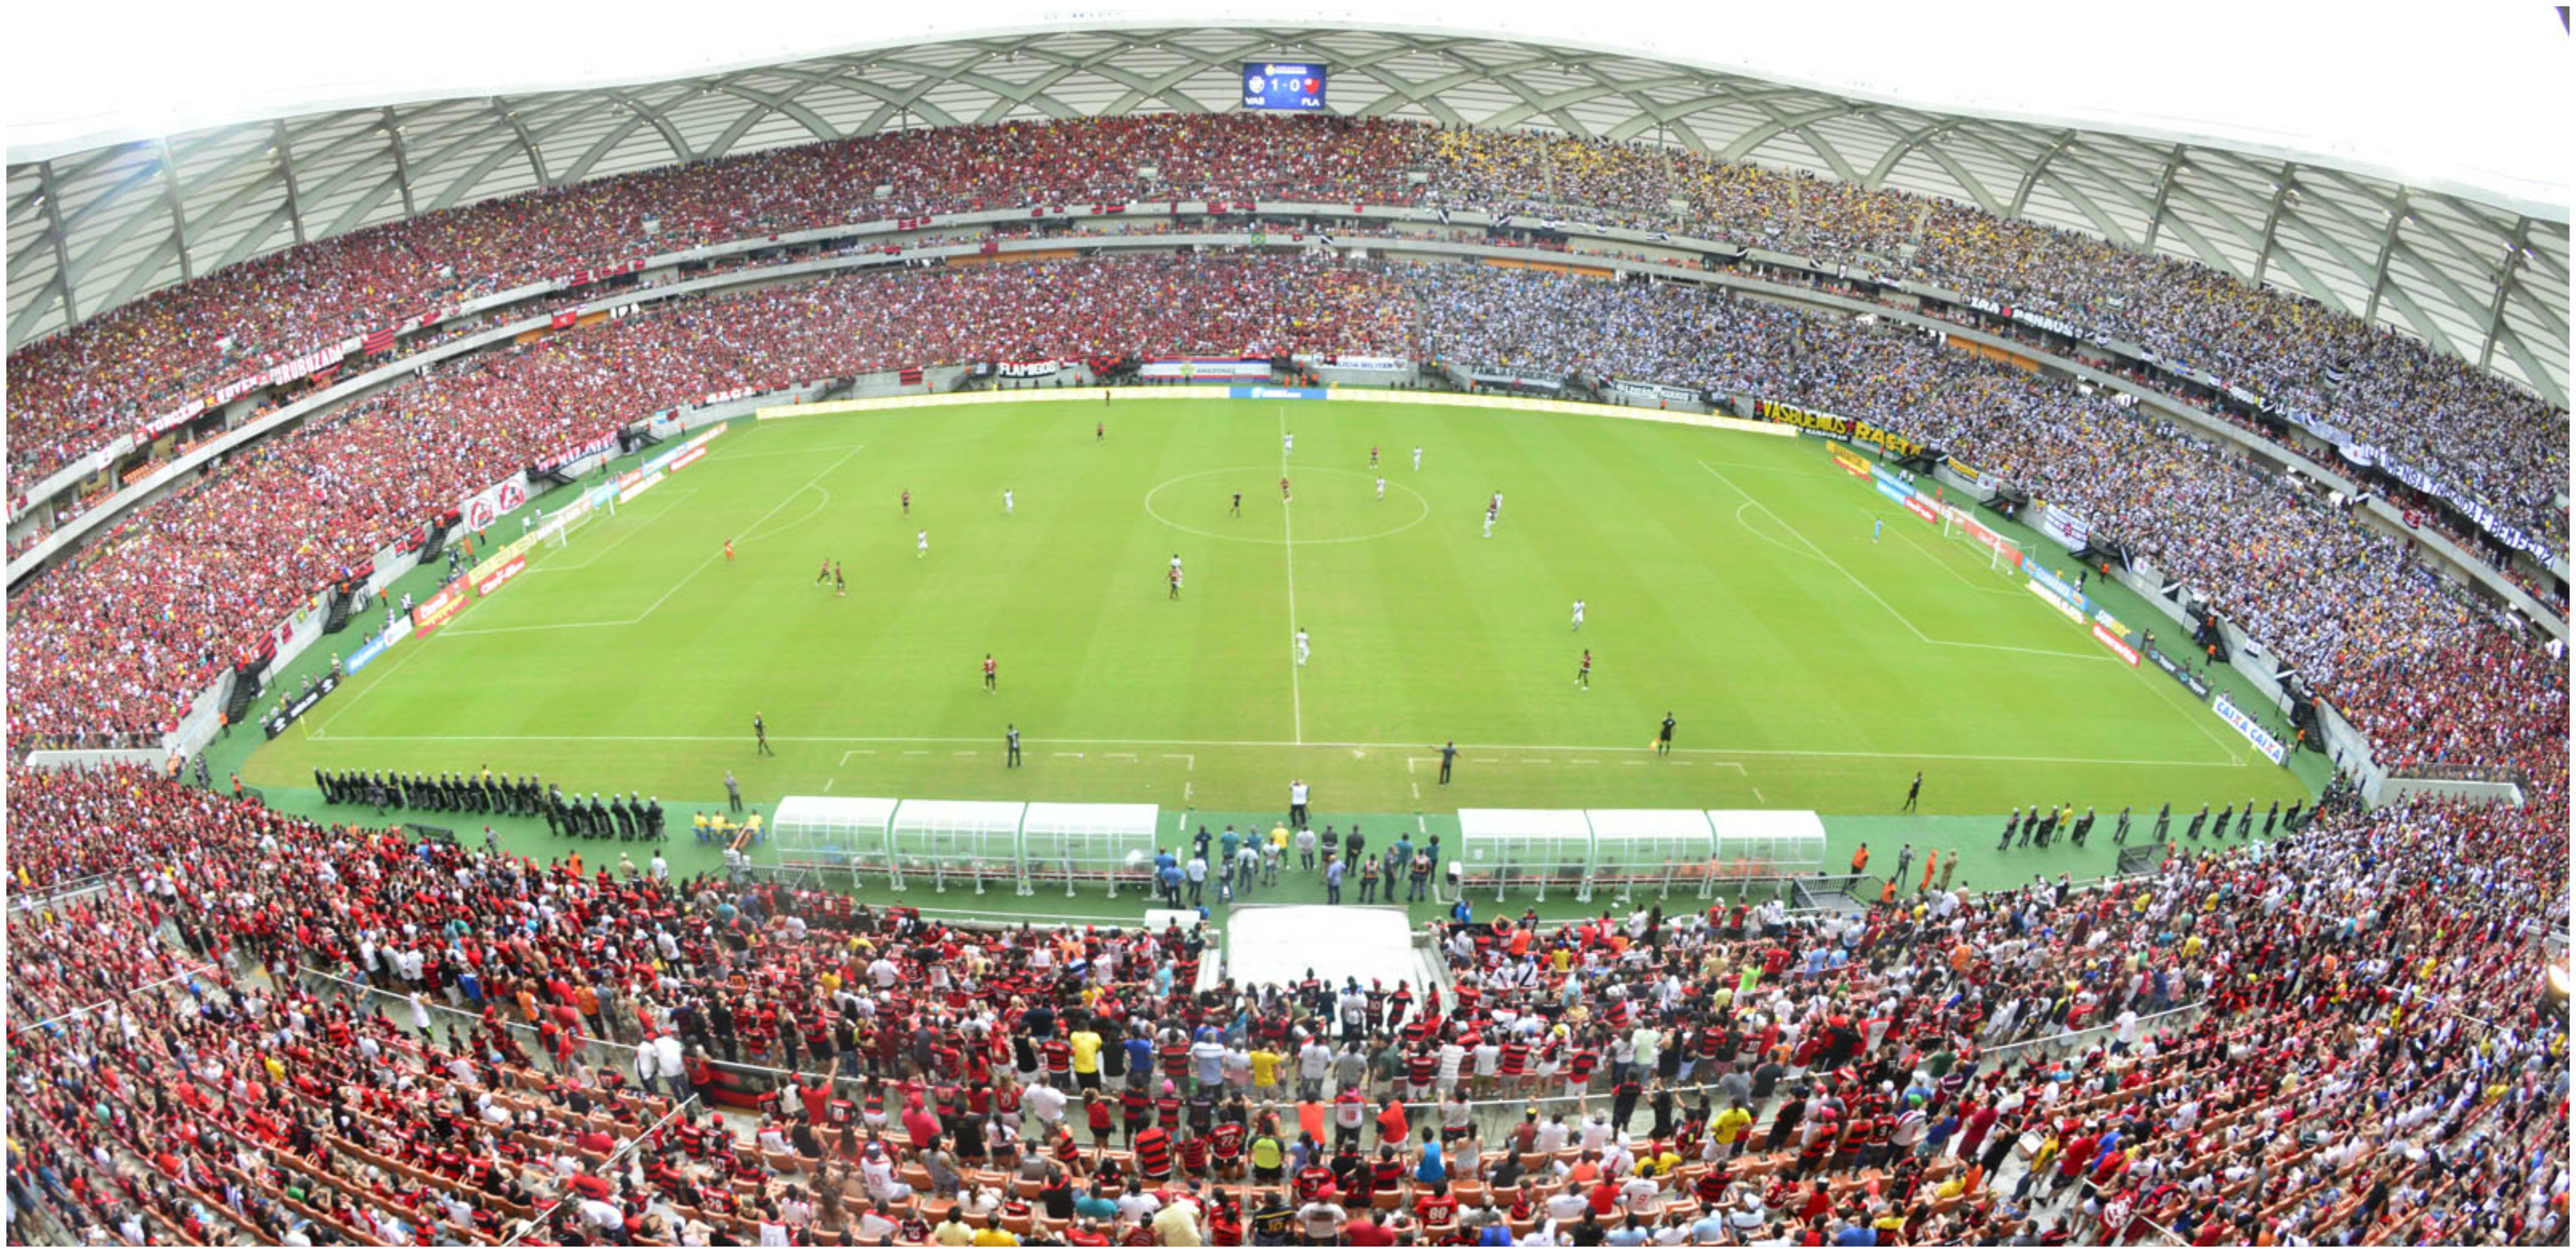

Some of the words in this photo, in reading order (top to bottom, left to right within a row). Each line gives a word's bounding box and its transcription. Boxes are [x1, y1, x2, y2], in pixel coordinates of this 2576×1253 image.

[1271, 78, 1278, 91] 1
[1289, 78, 1300, 91] 0
[1245, 97, 1265, 106] VAS
[1301, 98, 1320, 106] FLA
[2216, 701, 2249, 733] CAIXA
[2250, 728, 2281, 761] CAIXA
